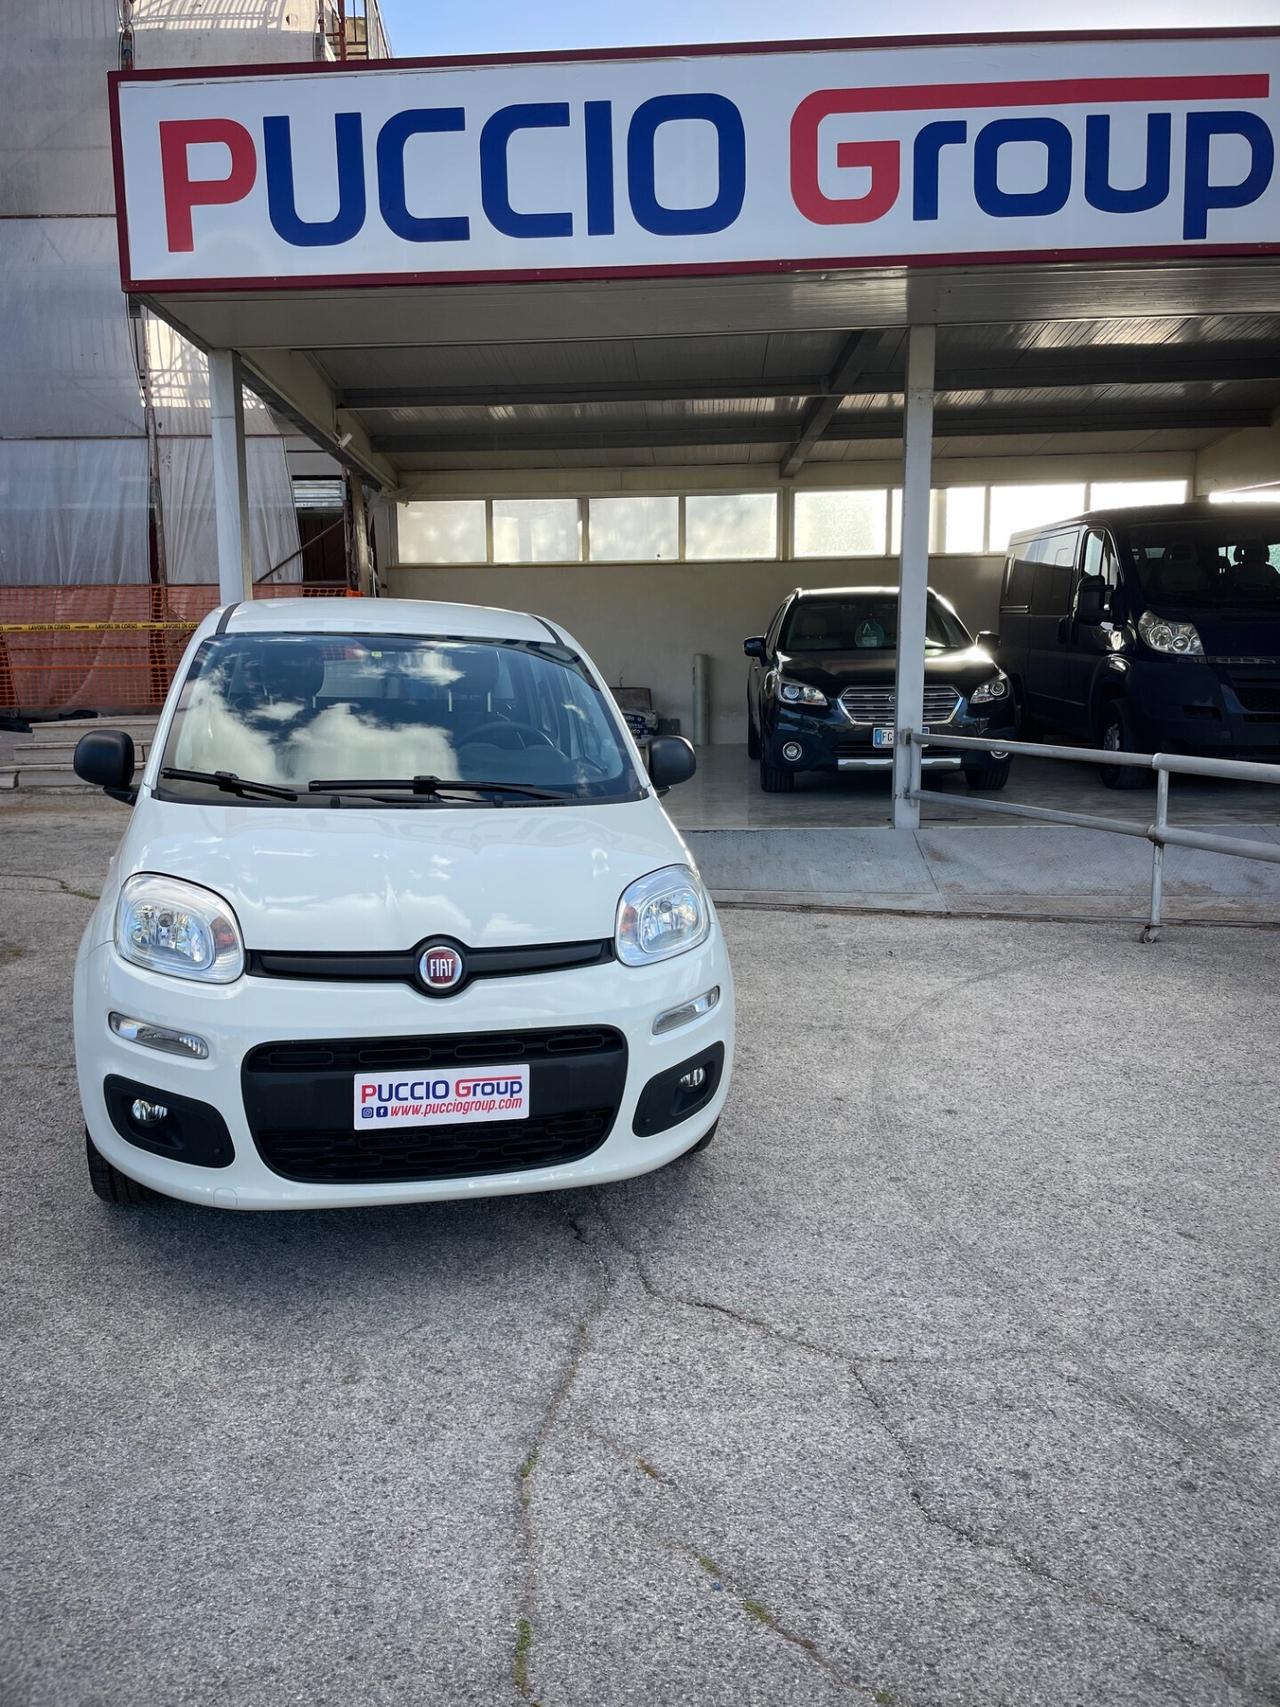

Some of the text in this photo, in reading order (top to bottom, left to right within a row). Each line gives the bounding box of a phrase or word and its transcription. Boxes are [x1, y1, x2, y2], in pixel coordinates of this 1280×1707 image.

[159, 73, 1275, 253] PUCCIO Group
[430, 958, 454, 977] FIAT
[361, 1076, 523, 1104] PUCCIO Group
[390, 1097, 523, 1118] www.pucciogroup.com
